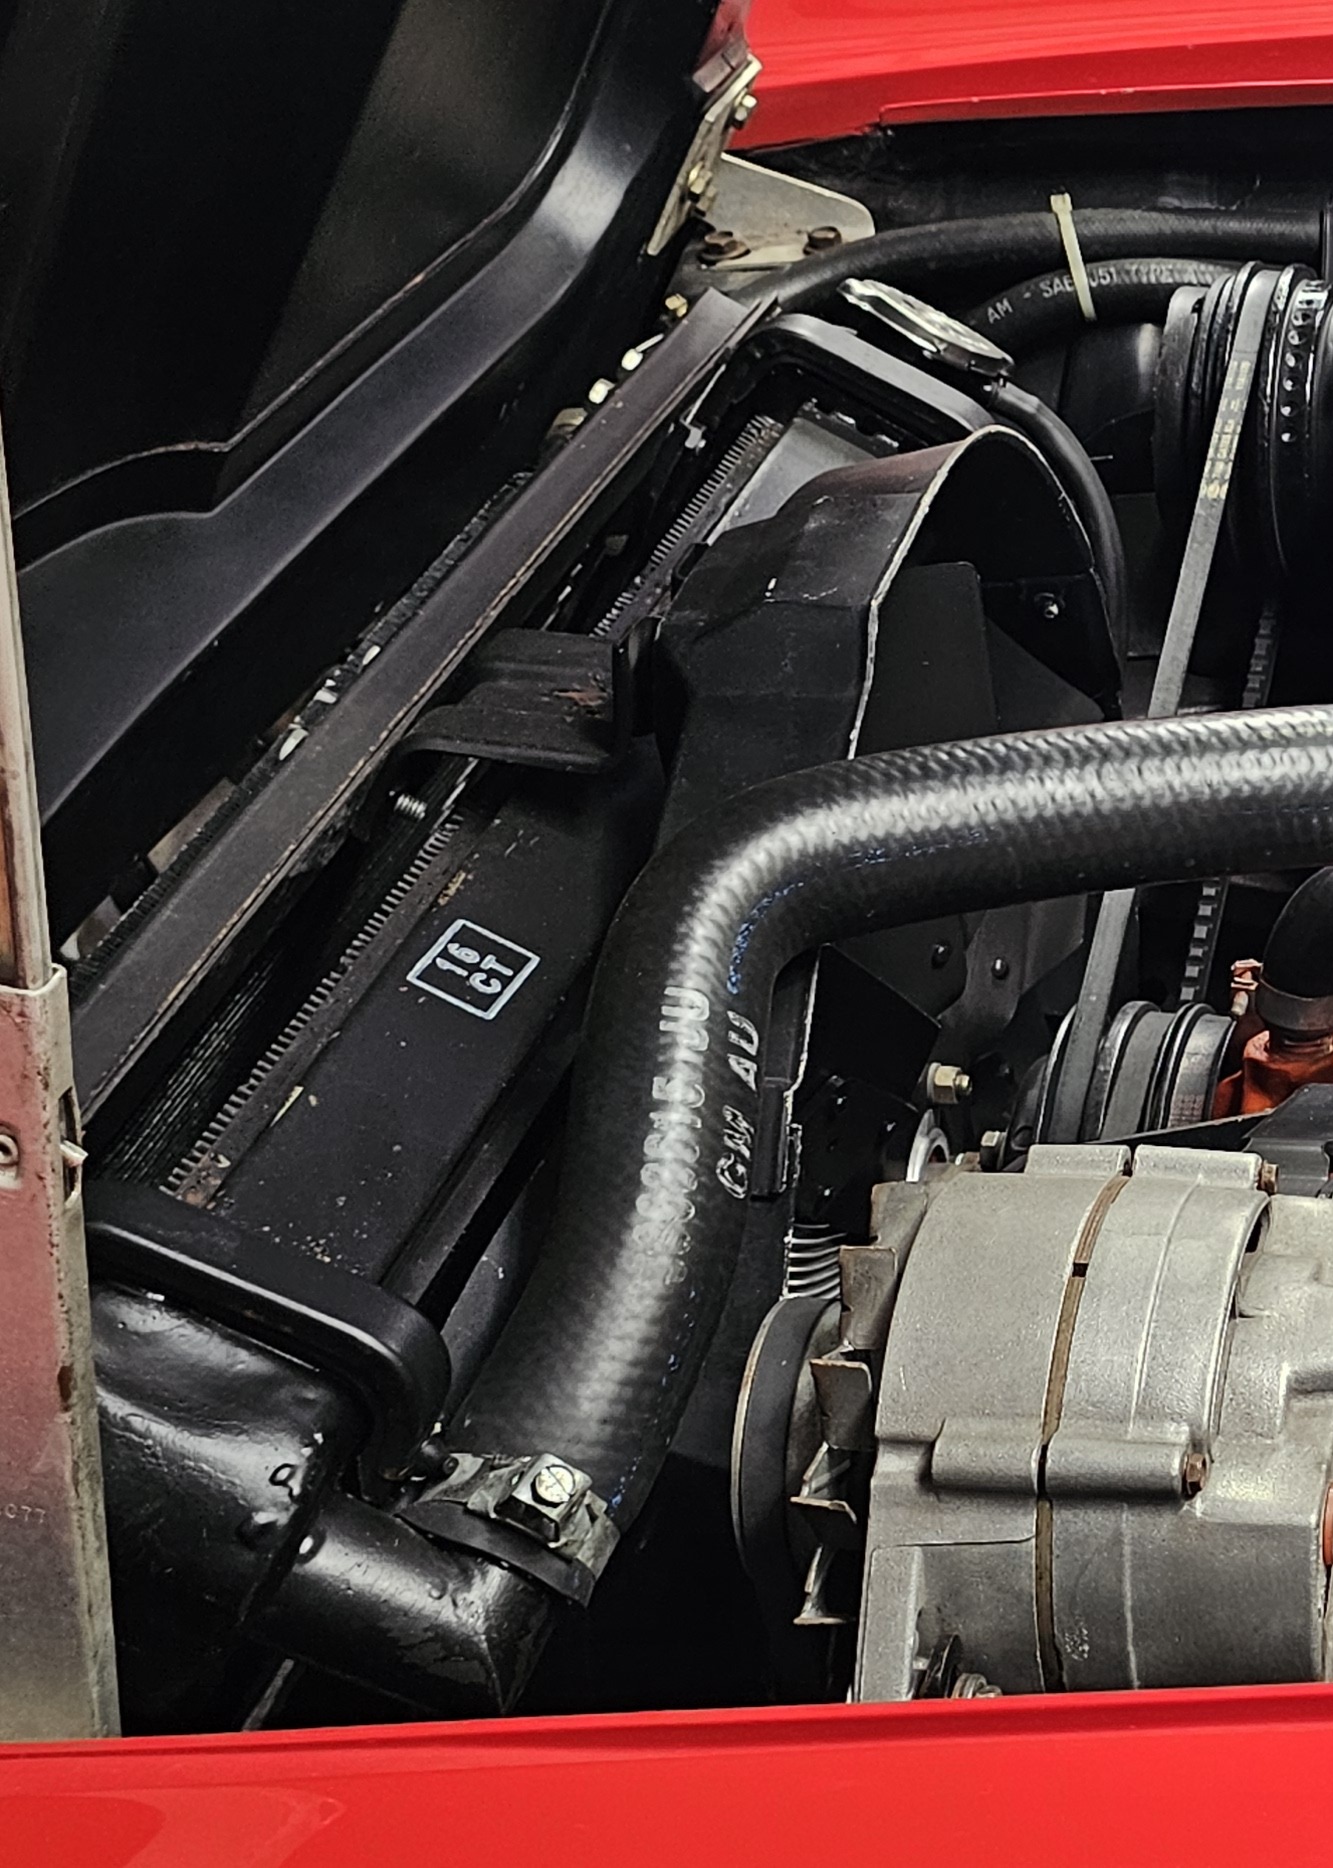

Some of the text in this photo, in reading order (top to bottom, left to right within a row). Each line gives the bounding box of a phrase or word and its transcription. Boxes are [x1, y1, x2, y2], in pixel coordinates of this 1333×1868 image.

[986, 298, 1014, 324] AM
[1039, 274, 1077, 298] SAE
[435, 943, 481, 978] 16
[469, 954, 514, 994] CT
